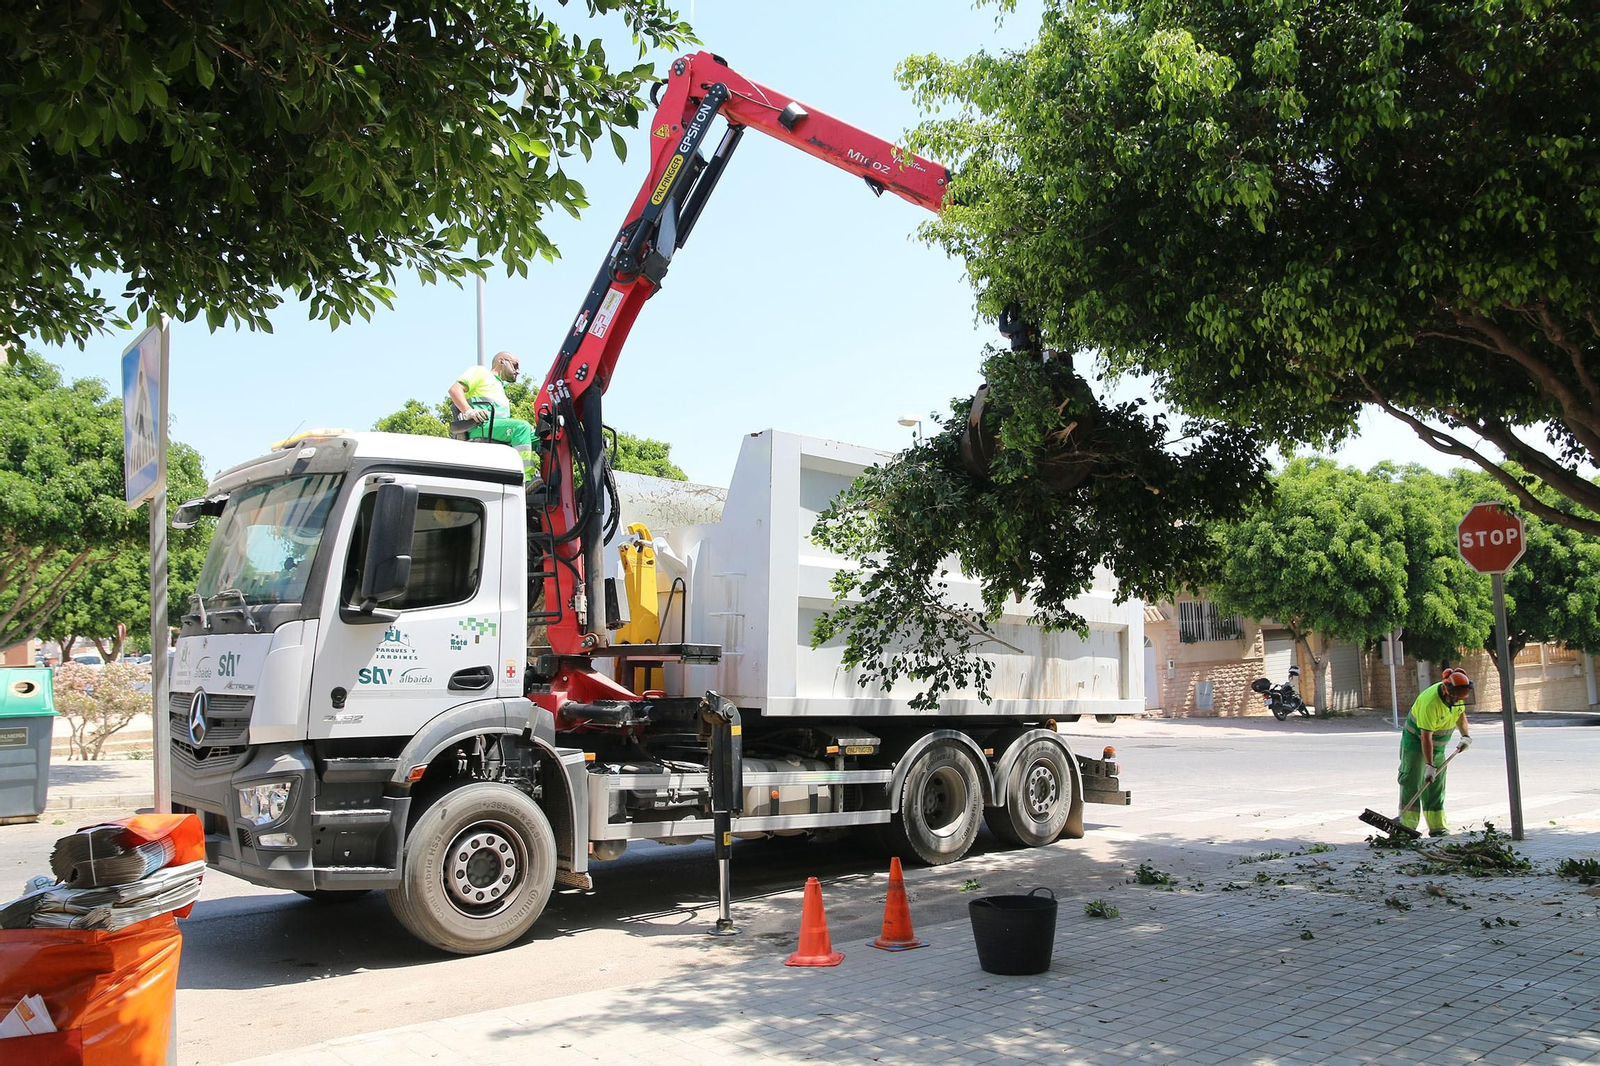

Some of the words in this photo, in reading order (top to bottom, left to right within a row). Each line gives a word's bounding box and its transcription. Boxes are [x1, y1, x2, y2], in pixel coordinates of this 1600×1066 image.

[653, 156, 682, 203] PALFINGER
[1461, 528, 1518, 548] STOP
[398, 674, 433, 684] albaida
[425, 859, 433, 894] Hybrid
[429, 834, 442, 856] HS3
